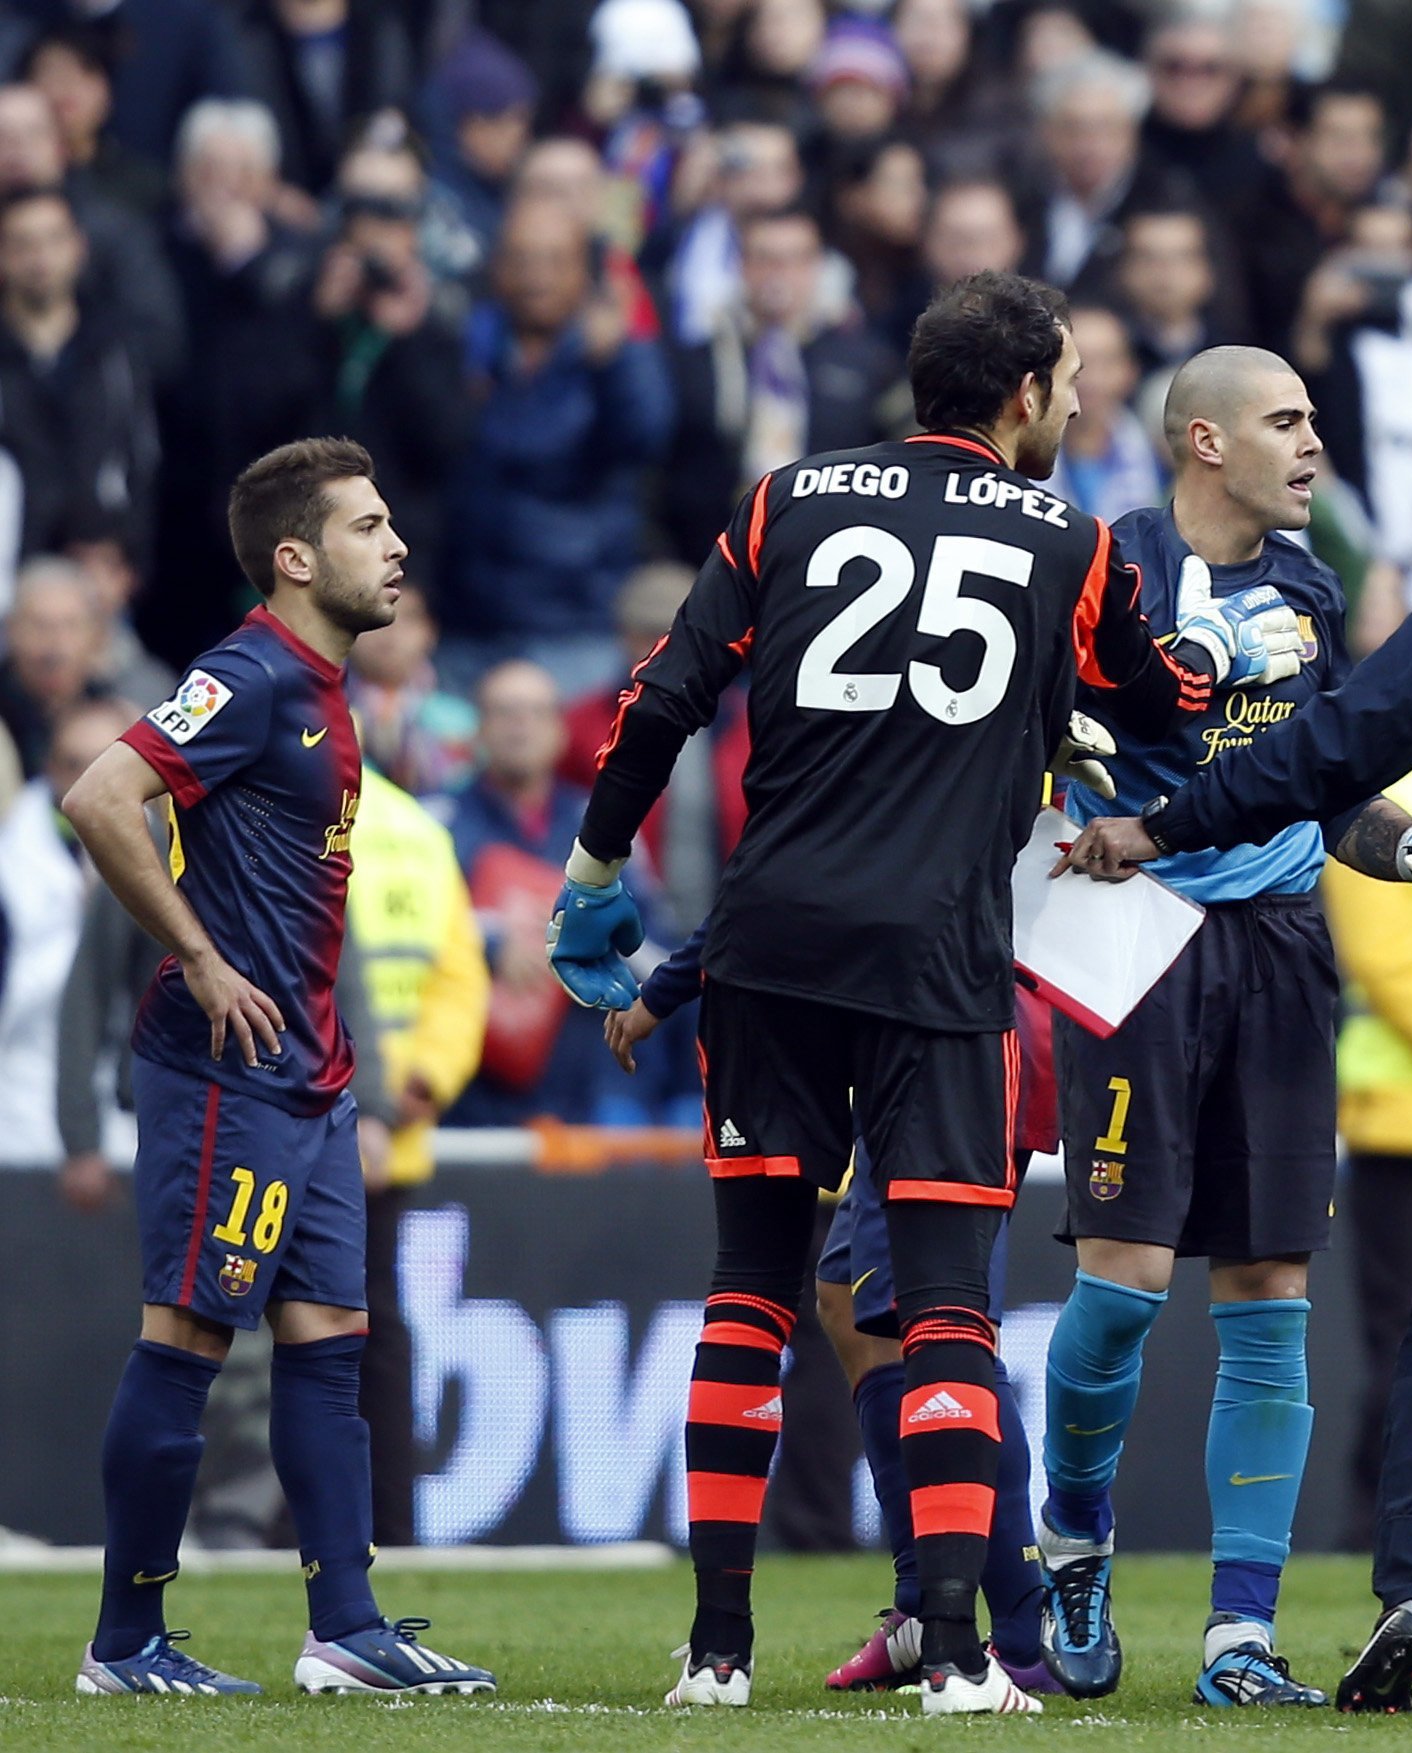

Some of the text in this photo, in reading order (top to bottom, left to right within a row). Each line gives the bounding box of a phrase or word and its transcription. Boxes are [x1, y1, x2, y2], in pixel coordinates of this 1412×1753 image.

[791, 463, 1070, 529] DIEGO LÓPEZ
[795, 525, 1036, 726] 25
[153, 703, 190, 733] LFP
[1224, 691, 1295, 734] Qatar
[1094, 1076, 1132, 1155] 1
[212, 1166, 288, 1254] 18
[907, 1408, 973, 1423] adidas
